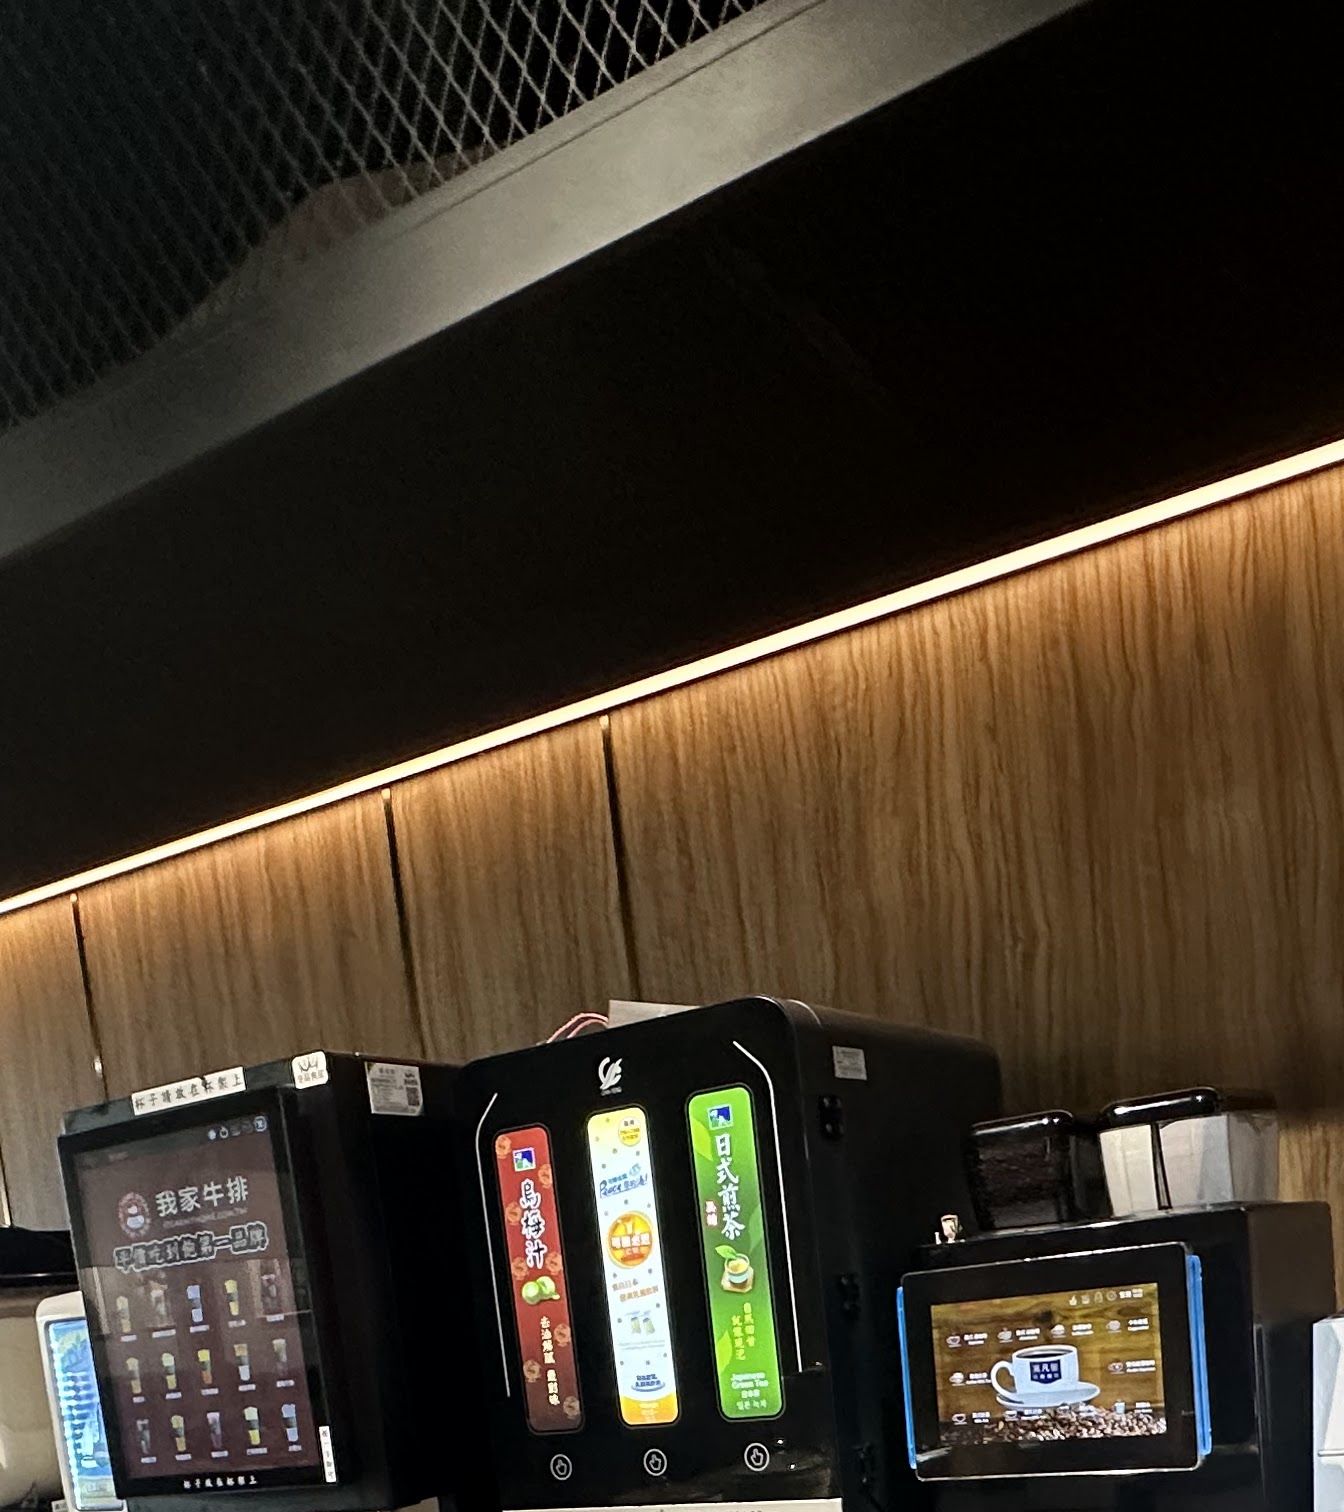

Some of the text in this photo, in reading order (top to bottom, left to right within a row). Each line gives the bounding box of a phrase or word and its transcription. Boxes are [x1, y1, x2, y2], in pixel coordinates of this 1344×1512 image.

[155, 1175, 249, 1217] 我家牛排
[715, 1133, 746, 1240] 日式煎茶
